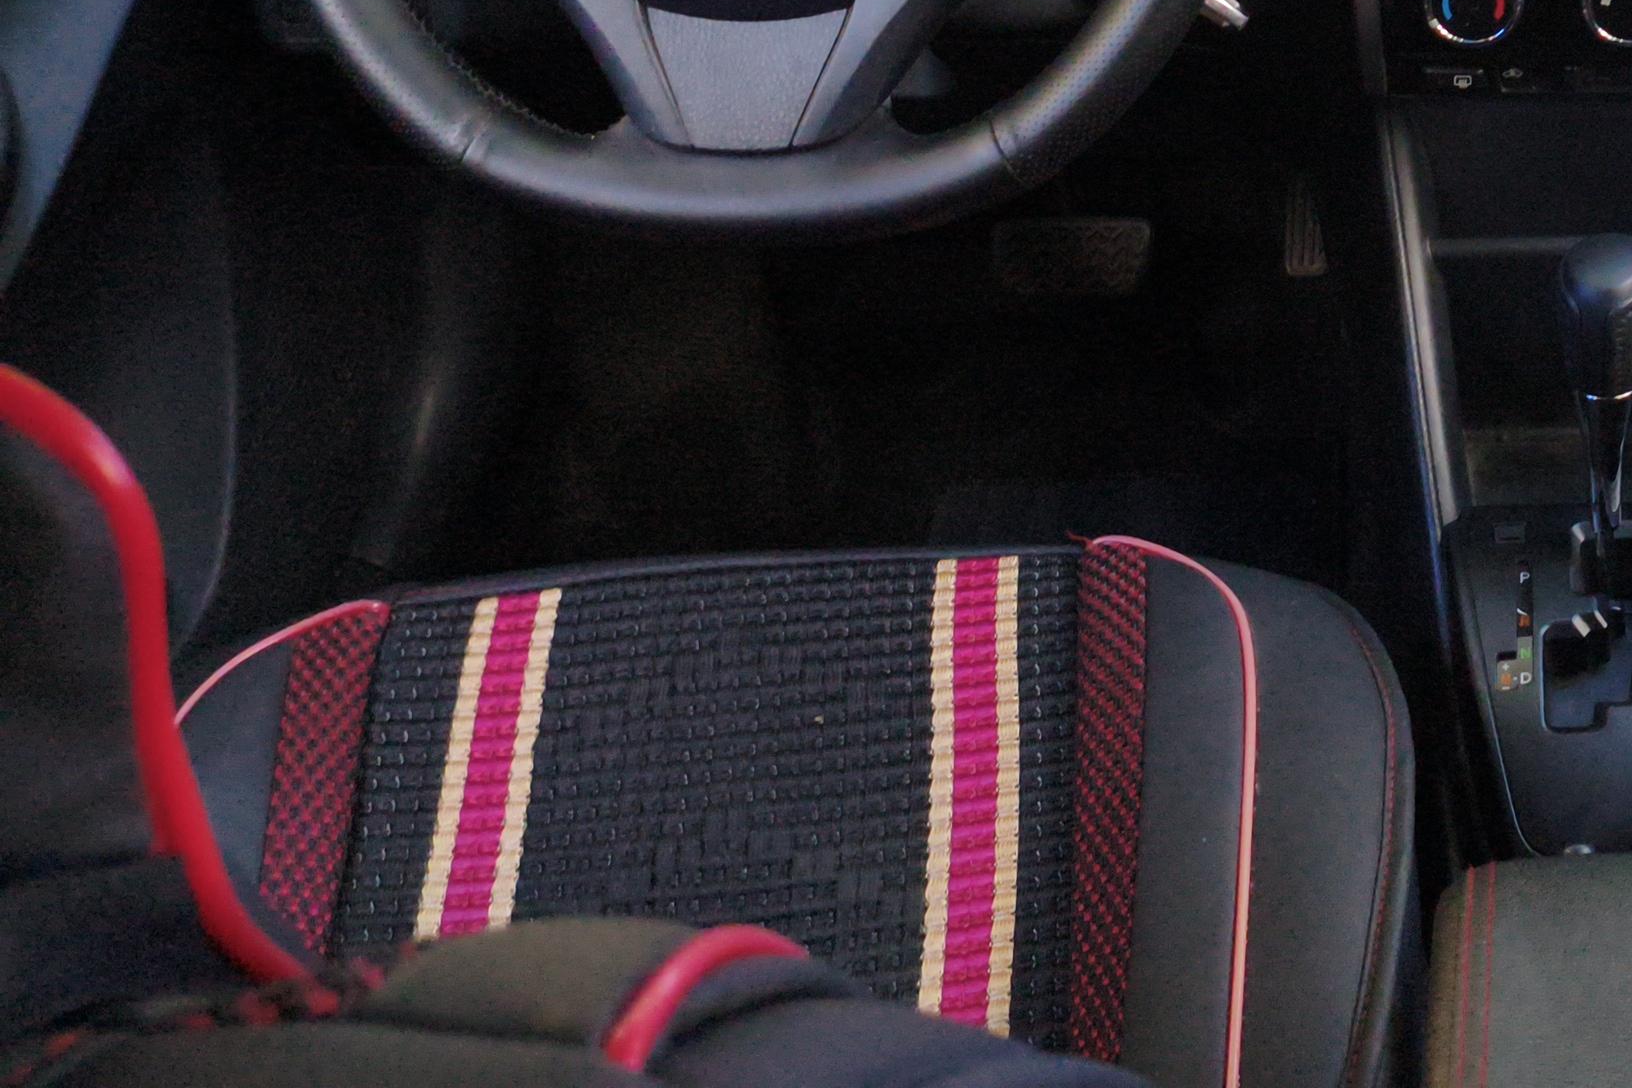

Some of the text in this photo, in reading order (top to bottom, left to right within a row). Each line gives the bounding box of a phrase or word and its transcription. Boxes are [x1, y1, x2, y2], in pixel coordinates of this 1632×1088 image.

[1520, 572, 1530, 584] P
[1520, 648, 1531, 659] N
[1520, 672, 1532, 685] D
